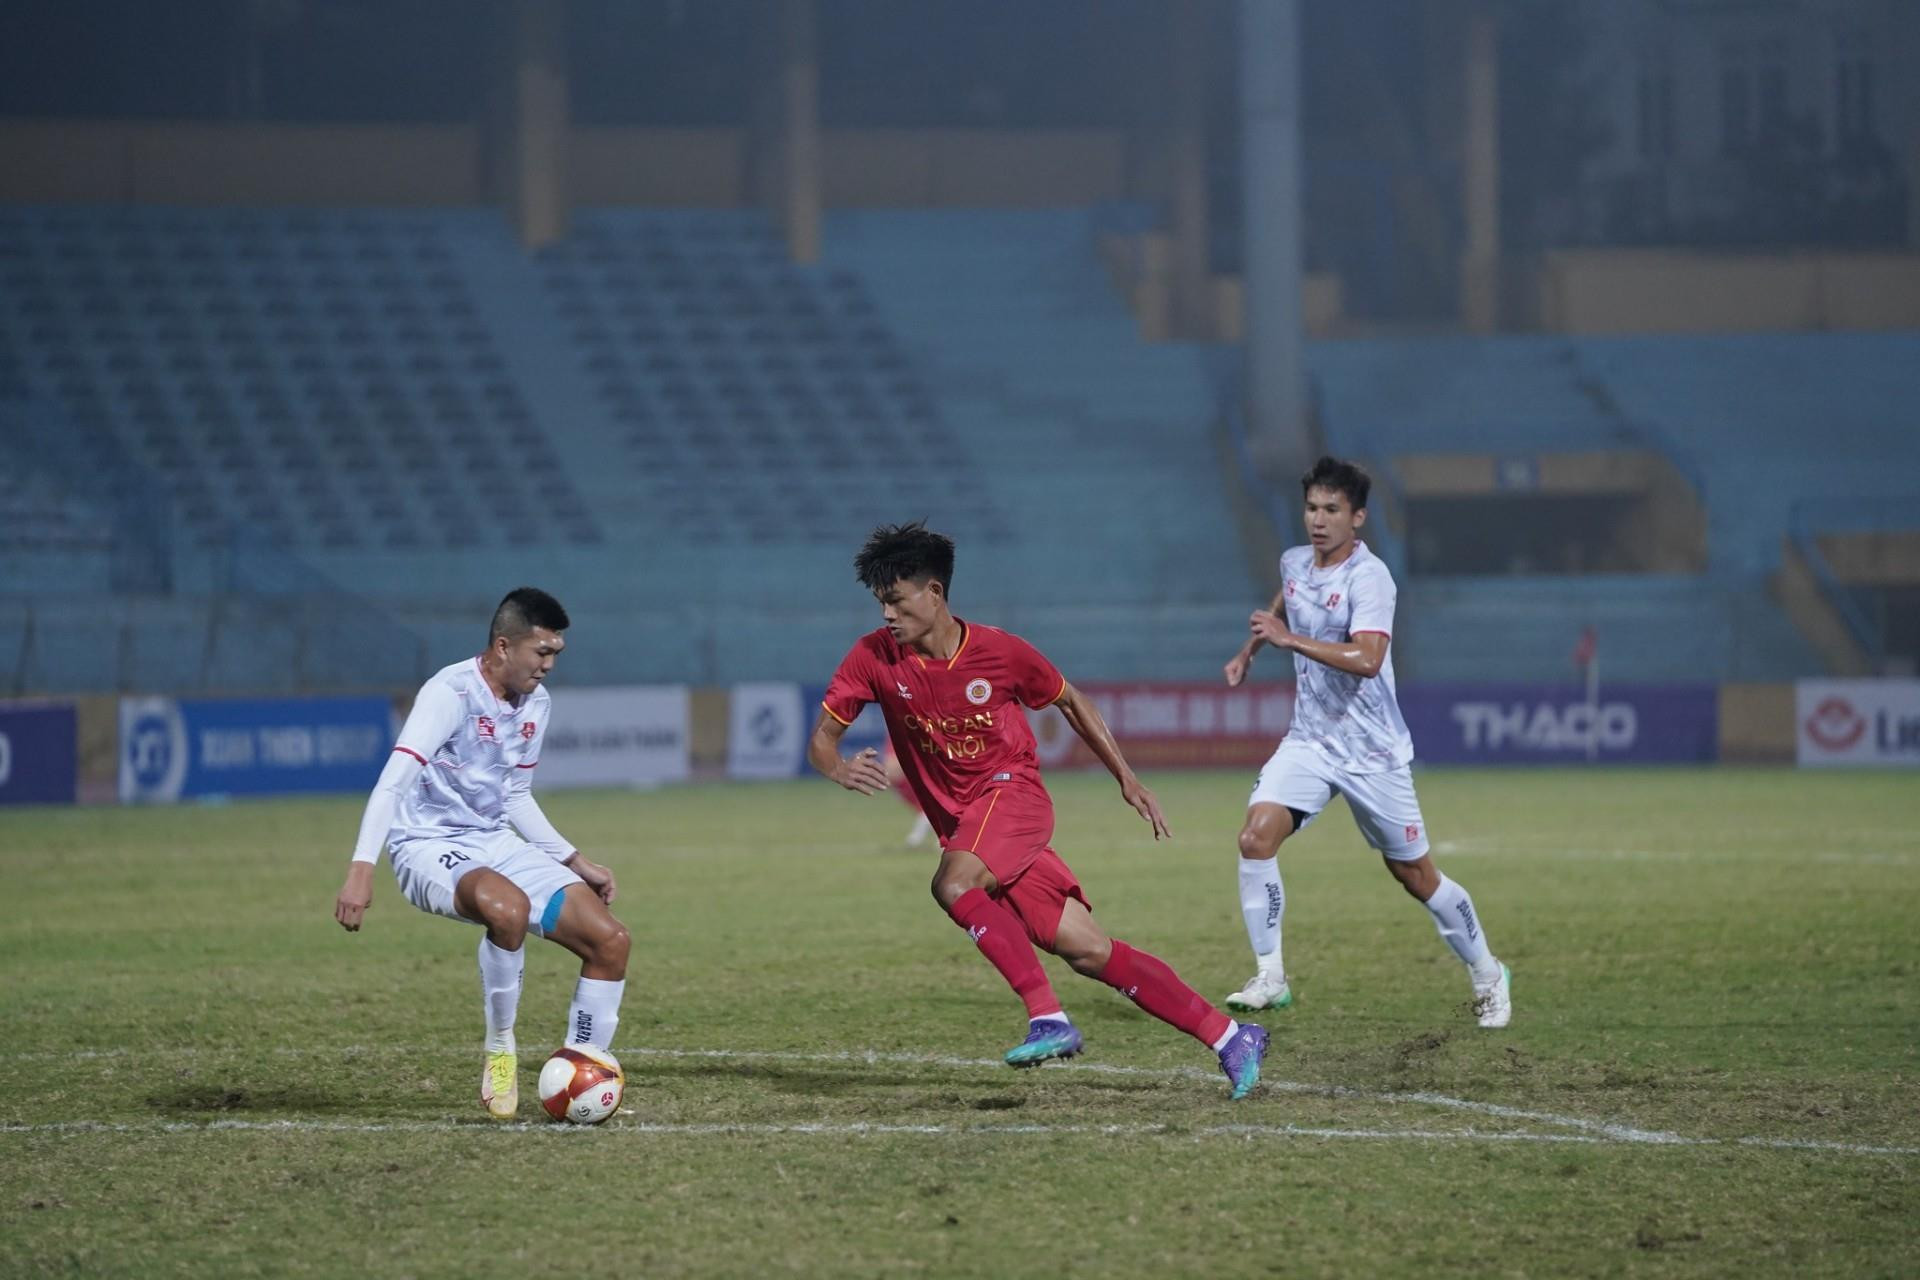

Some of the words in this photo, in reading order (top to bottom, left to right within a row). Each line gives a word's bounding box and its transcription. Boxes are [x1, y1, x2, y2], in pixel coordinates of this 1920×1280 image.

[963, 712, 993, 732] AN
[1453, 702, 1638, 750] THACO
[946, 735, 987, 760] NỘI
